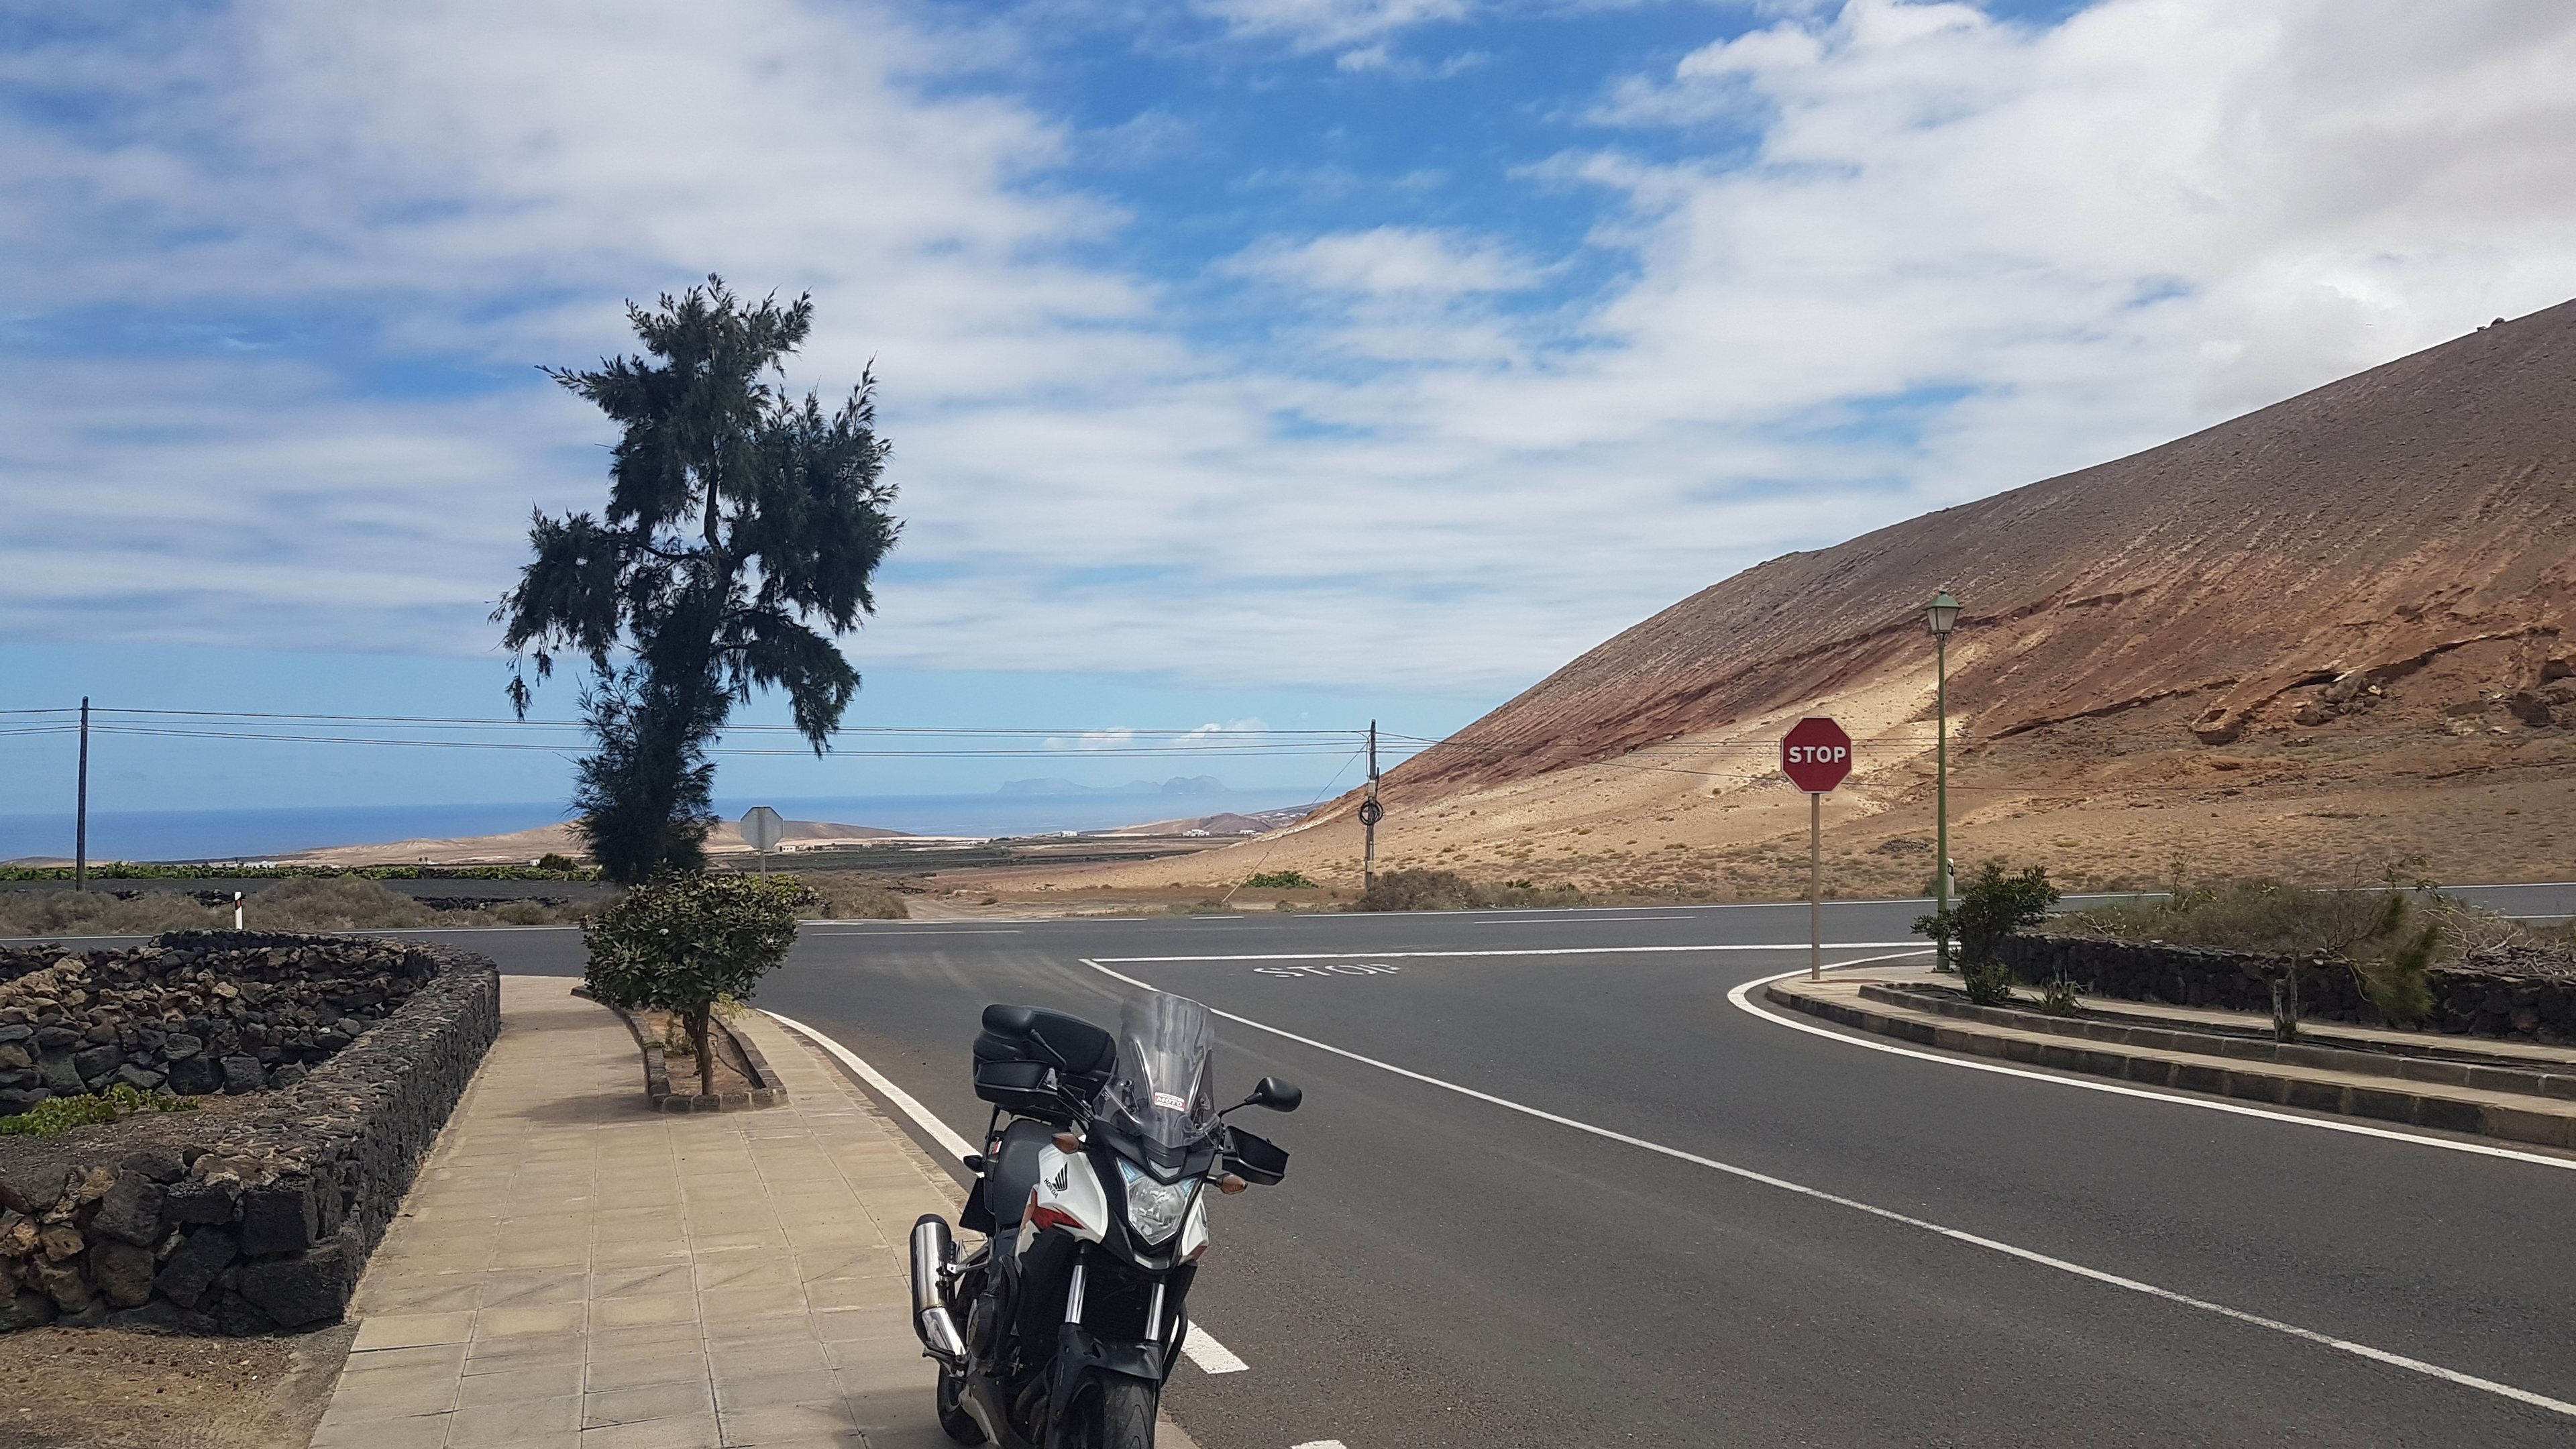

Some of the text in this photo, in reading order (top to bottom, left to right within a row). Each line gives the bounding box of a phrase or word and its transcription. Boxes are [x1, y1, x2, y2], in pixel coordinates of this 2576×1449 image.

[1788, 746, 1846, 763] STOP
[1253, 964, 1401, 977] STOP
[1156, 1096, 1183, 1107] MOTO
[1044, 1178, 1059, 1199] HONDA
